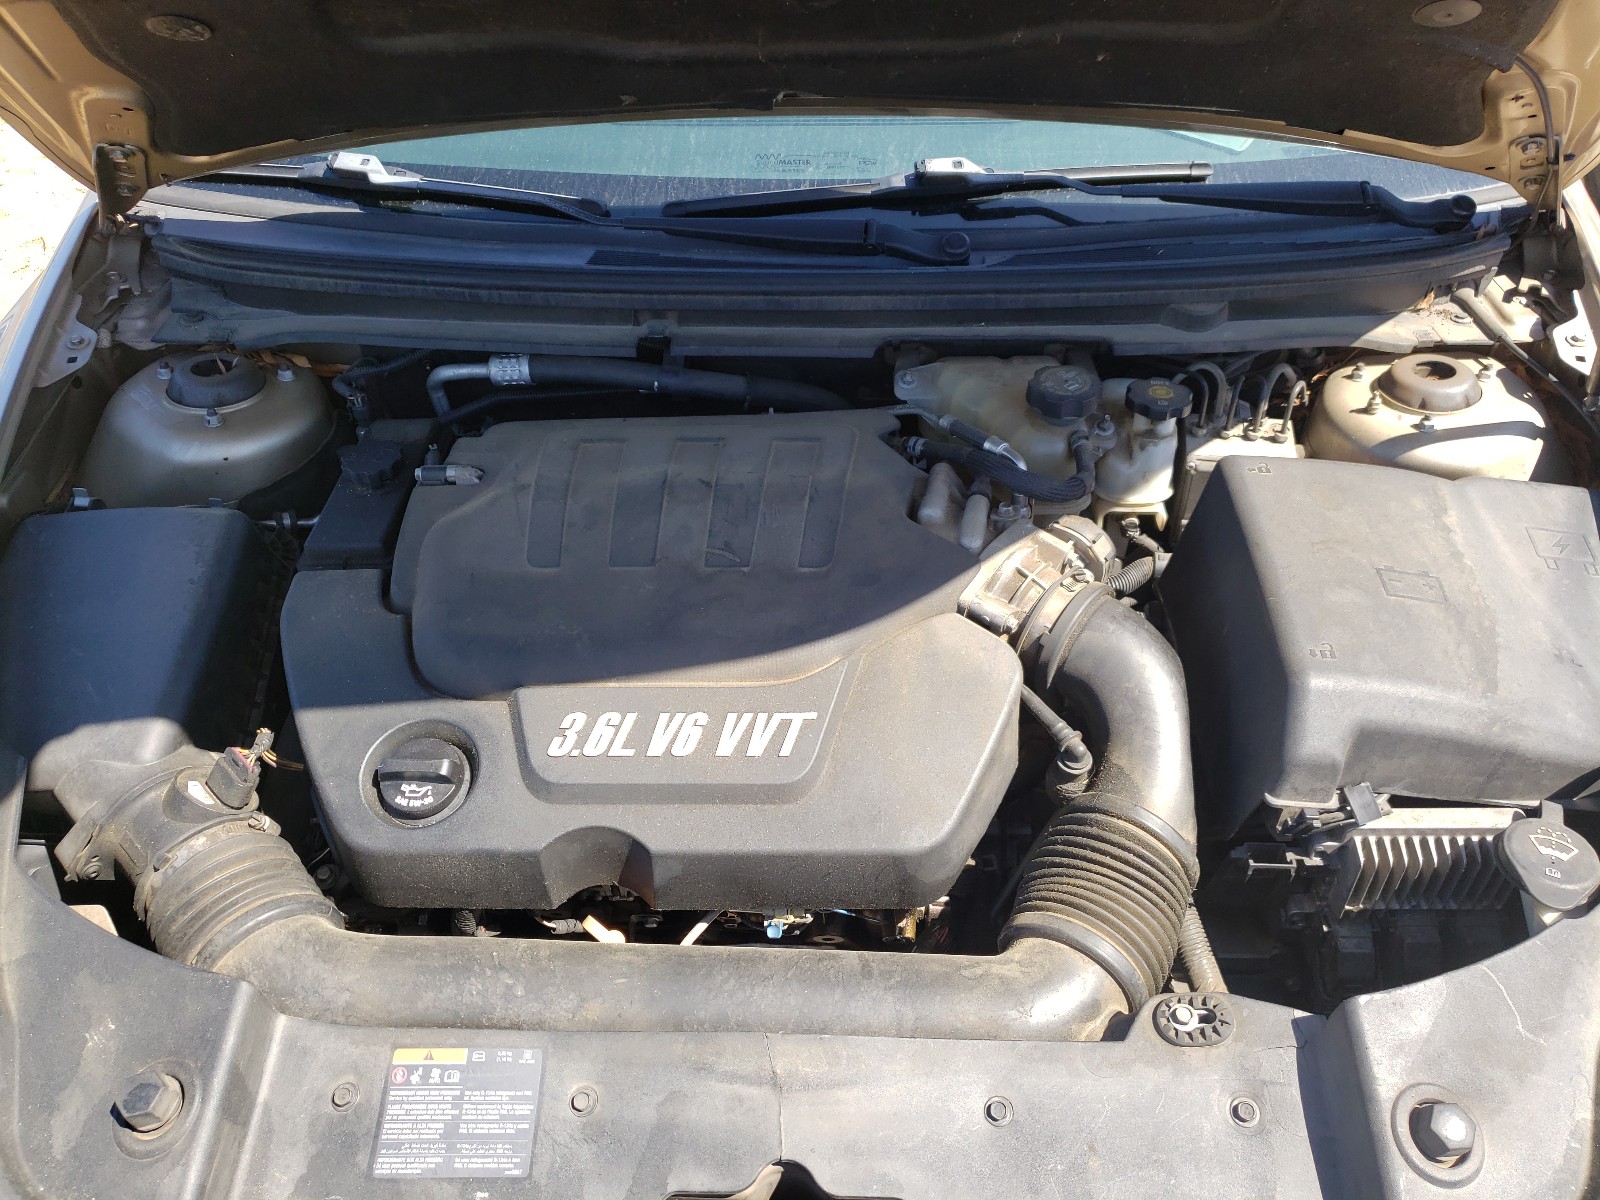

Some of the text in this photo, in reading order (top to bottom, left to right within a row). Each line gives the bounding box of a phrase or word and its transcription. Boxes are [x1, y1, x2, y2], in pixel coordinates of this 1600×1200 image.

[547, 711, 818, 757] 3.6L V6 VVT
